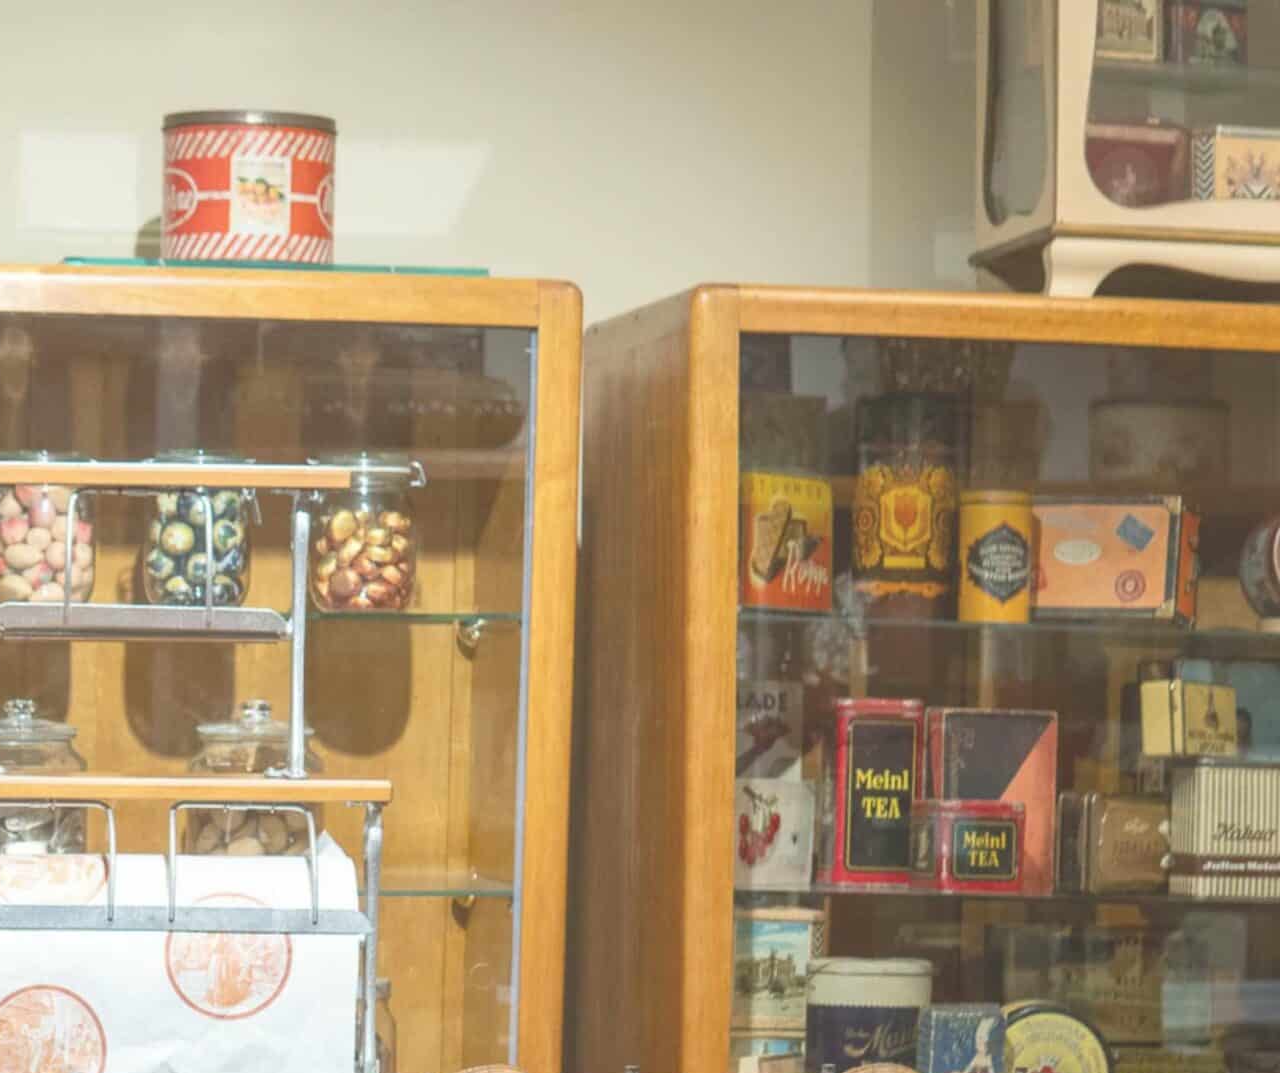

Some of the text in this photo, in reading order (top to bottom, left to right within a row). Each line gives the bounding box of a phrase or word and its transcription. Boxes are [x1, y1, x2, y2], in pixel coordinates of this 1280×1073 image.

[855, 768, 910, 790] Meinl
[861, 796, 902, 819] TEA
[962, 831, 1007, 849] Meinl
[968, 851, 1000, 867] TEA
